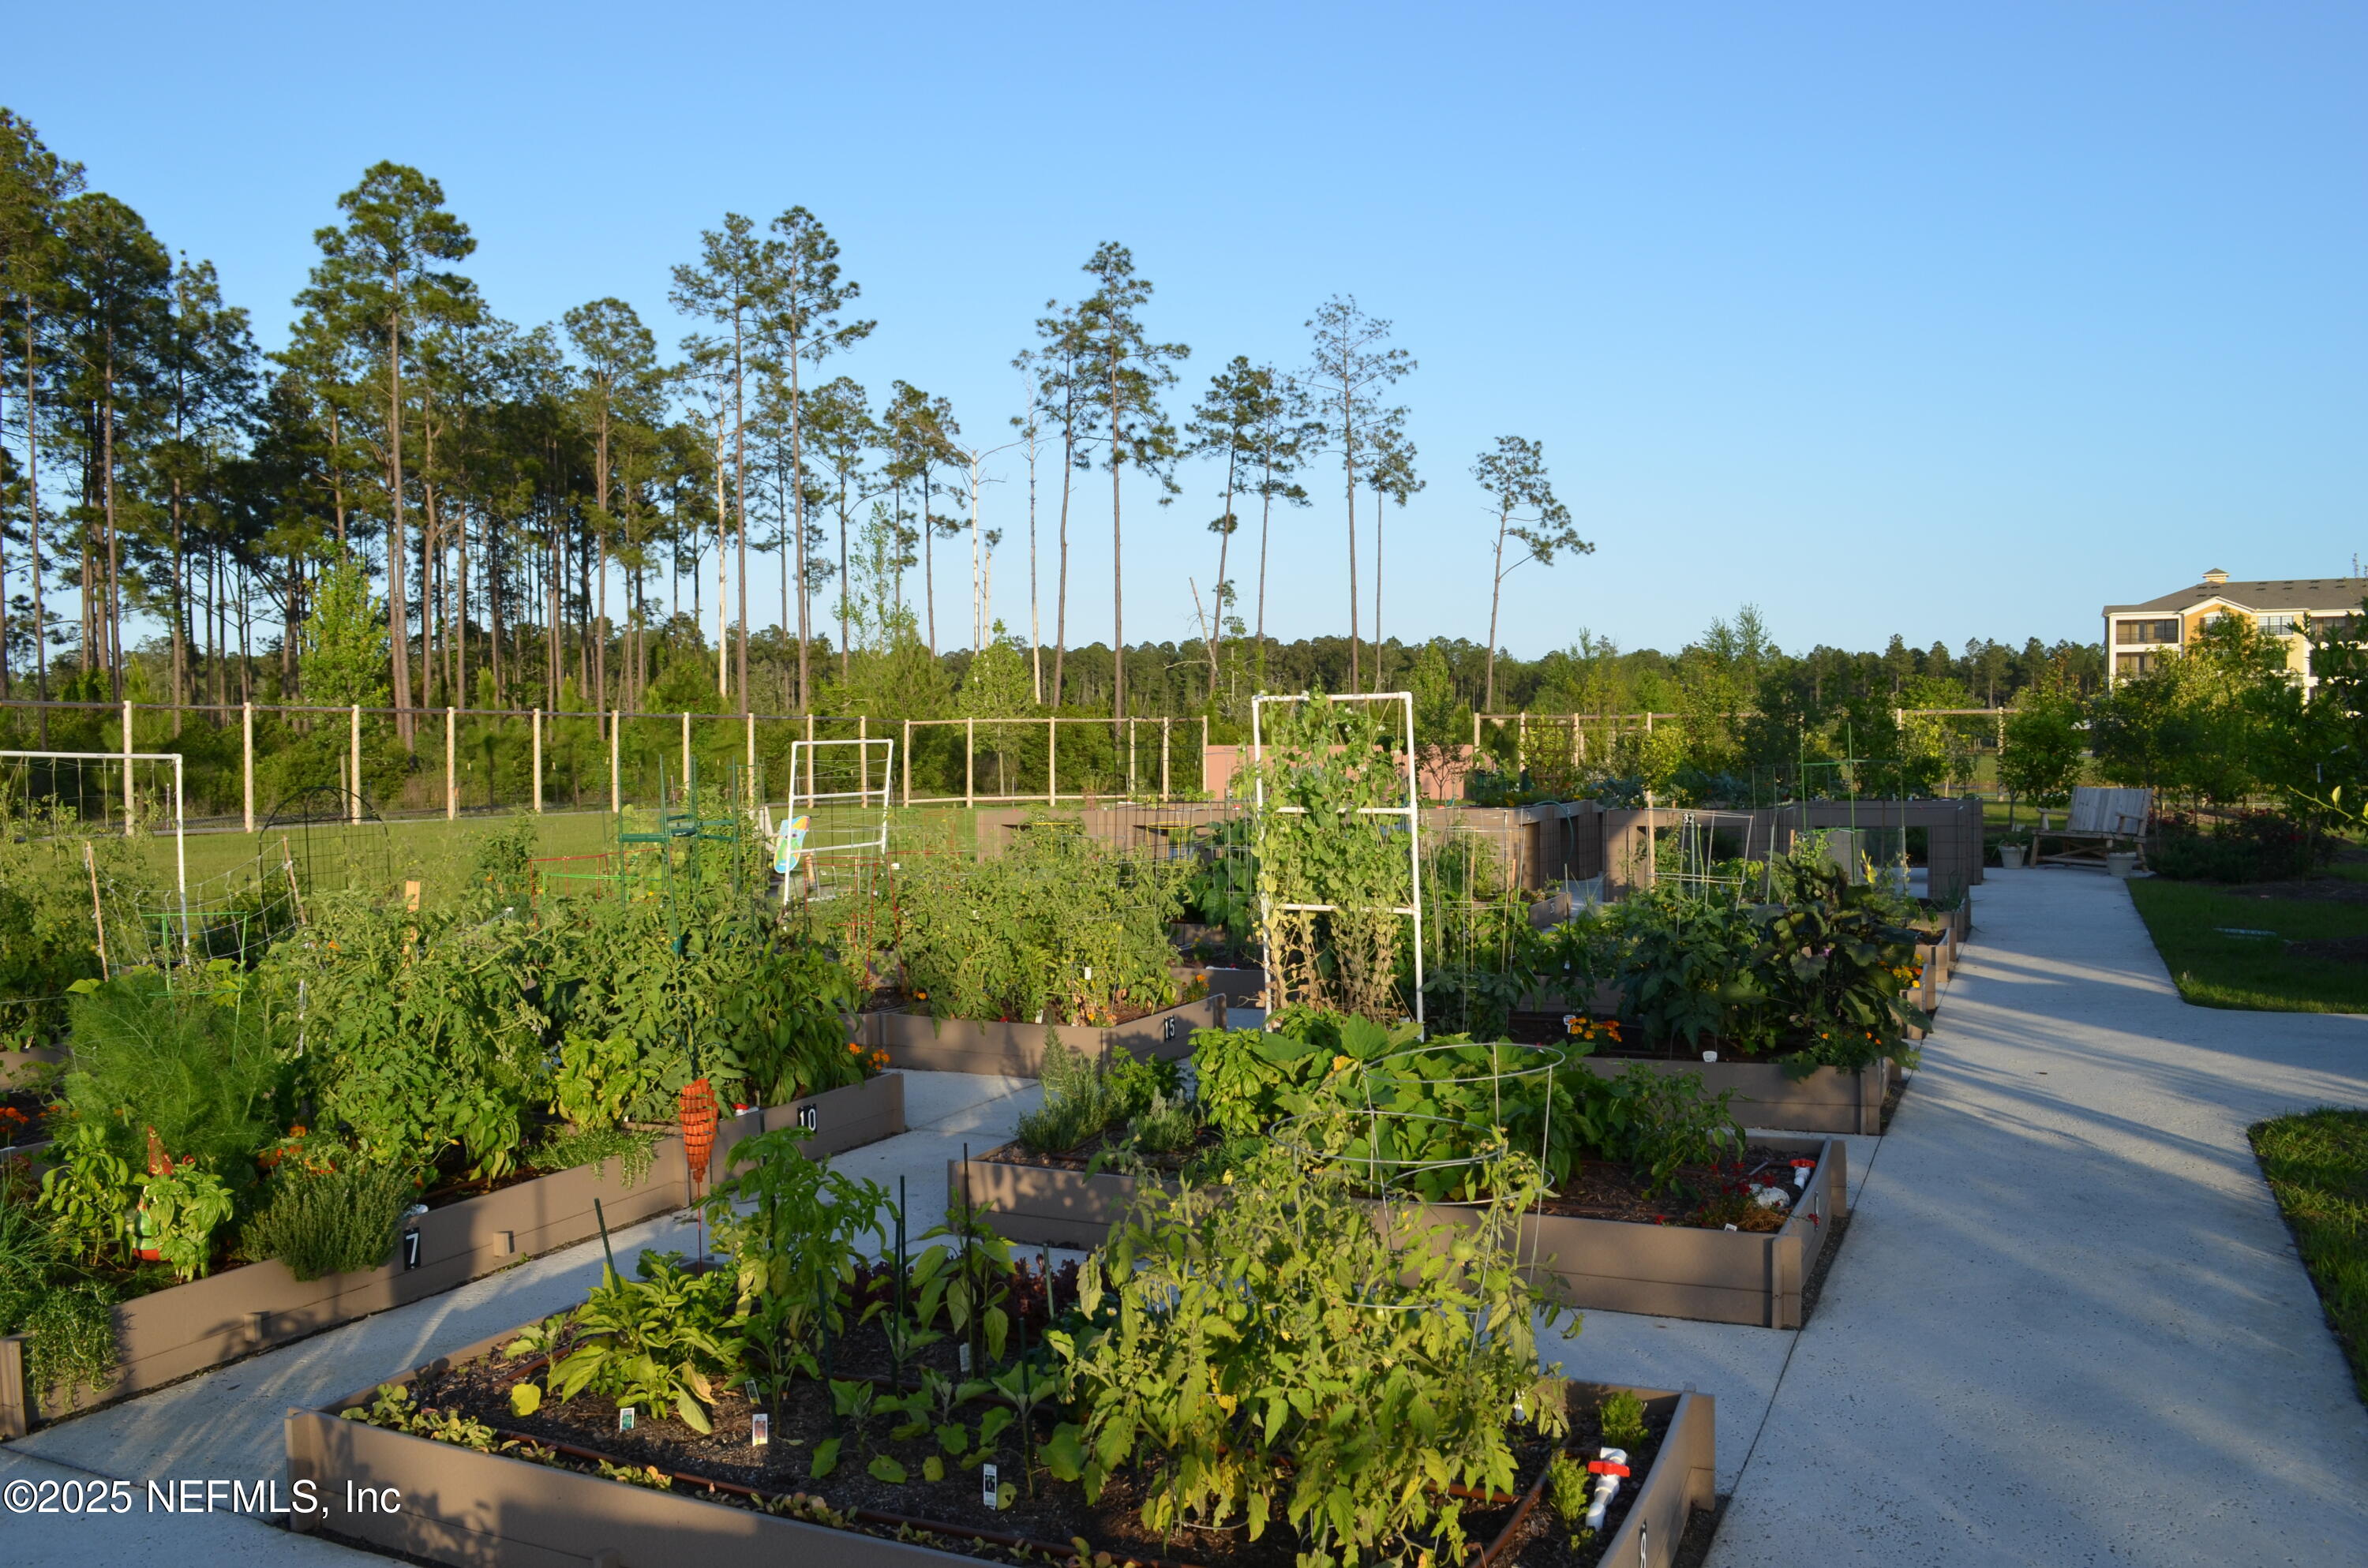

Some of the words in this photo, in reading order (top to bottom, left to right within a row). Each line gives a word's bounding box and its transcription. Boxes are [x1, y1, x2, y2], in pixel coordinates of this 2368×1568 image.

[1165, 1018, 1175, 1038] 15
[800, 1108, 816, 1132] 10
[405, 1233, 419, 1264] 7
